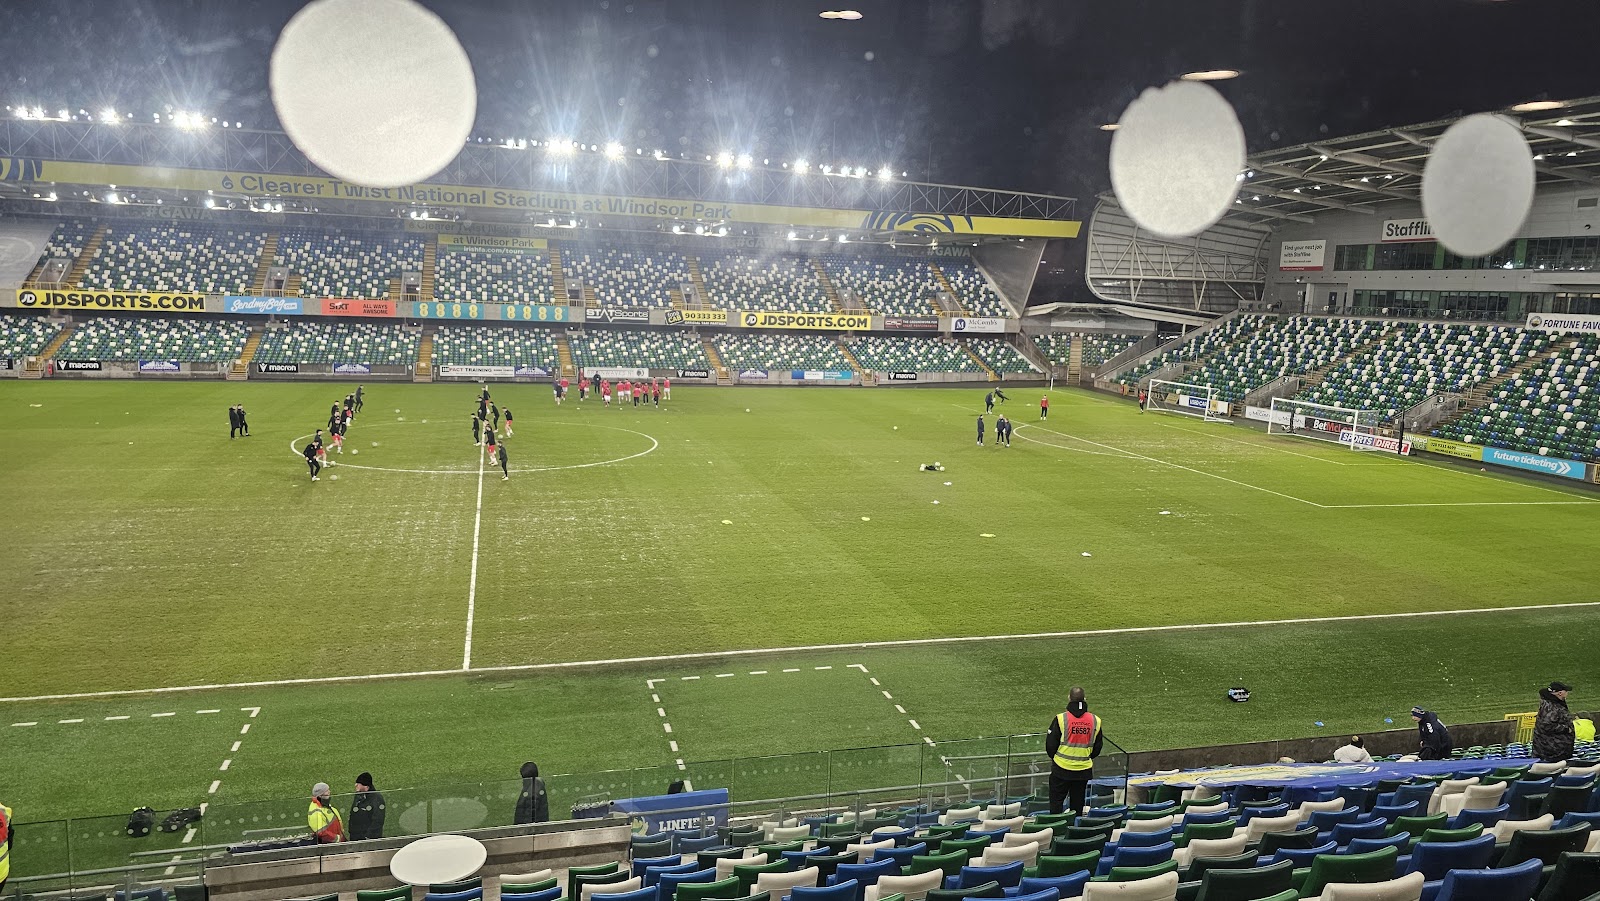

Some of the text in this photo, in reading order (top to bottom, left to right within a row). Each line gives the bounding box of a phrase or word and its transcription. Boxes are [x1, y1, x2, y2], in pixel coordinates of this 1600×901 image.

[240, 175, 732, 219] Clearer Twist National Stadium at Windsor Park
[146, 205, 213, 220] #GAWA
[533, 227, 574, 237] Stadium
[1386, 221, 1435, 237] Staffli
[466, 236, 510, 246] Windsor
[512, 238, 534, 247] Park
[926, 247, 971, 257] #GAWA
[21, 292, 204, 310] JD JDSPORTS.COM
[760, 315, 868, 328] JDSPORTS.COM
[1543, 319, 1580, 329] FORTUNE
[1342, 433, 1373, 445] SPORTS
[1376, 440, 1408, 452] DIRECT
[1493, 450, 1558, 470] future ticketing
[659, 816, 716, 832] LINFIED
